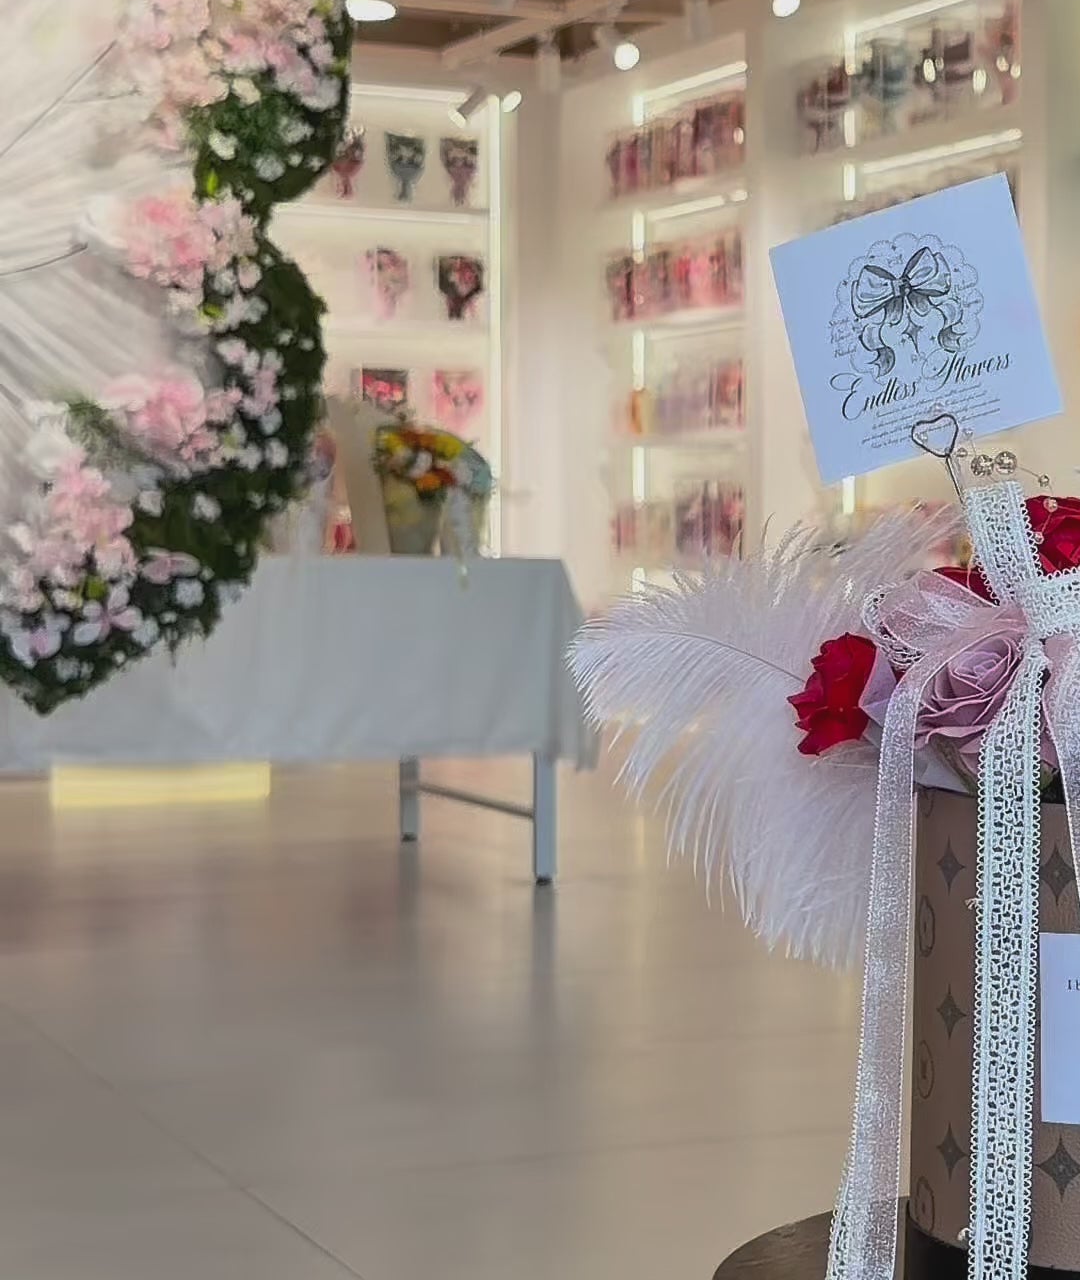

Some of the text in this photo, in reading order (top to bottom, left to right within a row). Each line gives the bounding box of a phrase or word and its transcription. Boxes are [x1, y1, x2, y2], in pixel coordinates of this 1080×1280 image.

[829, 372, 918, 421] Endless
[921, 351, 1010, 393] Flowers
[1067, 979, 1072, 991] I
